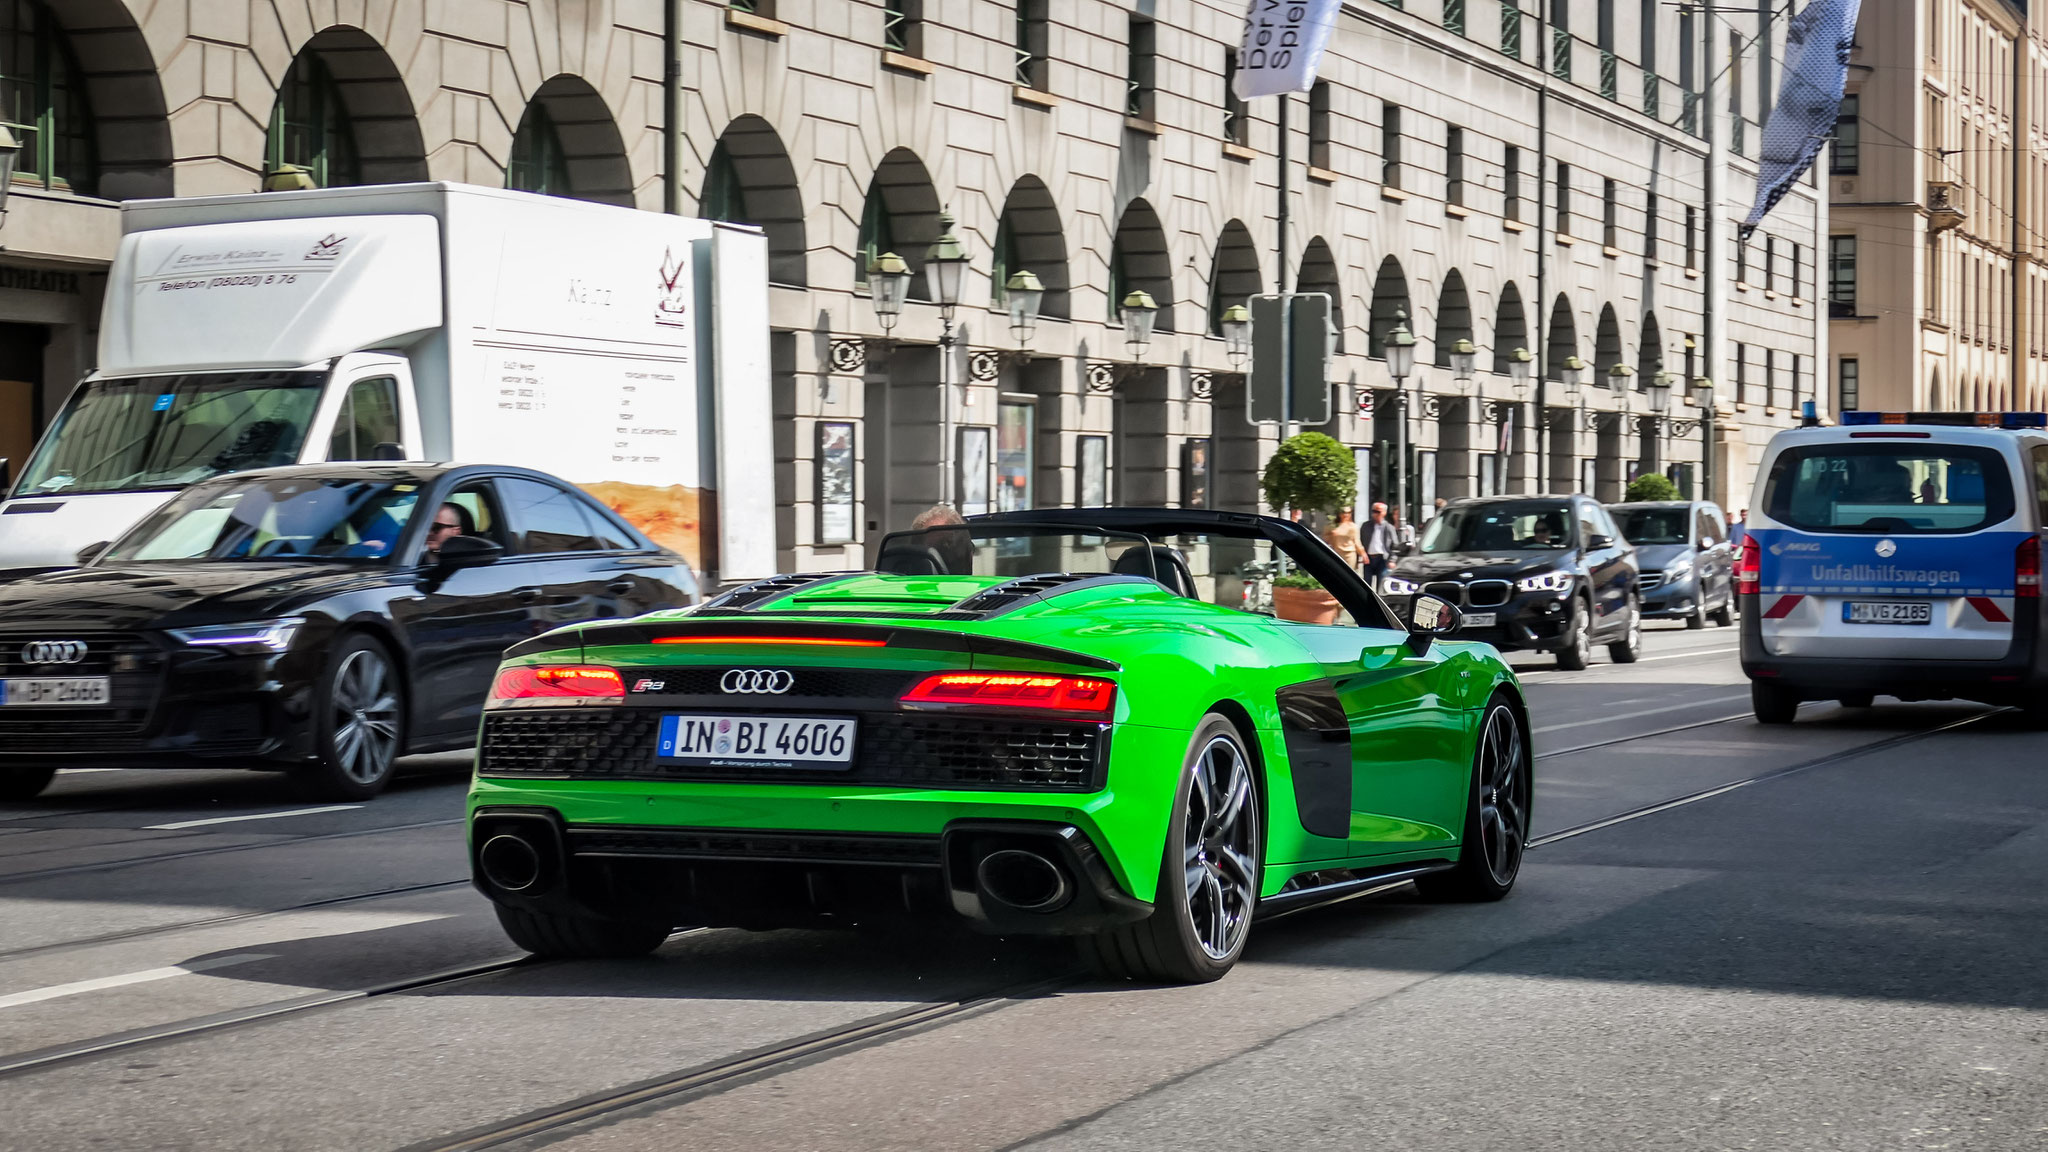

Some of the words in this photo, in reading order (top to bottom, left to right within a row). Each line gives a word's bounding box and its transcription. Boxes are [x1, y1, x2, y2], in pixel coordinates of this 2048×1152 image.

[1249, 18, 1274, 69] Der
[158, 280, 206, 291] Telefon
[207, 275, 263, 289] (08020)
[567, 278, 612, 306] Kaz
[1831, 459, 1848, 473] 22
[1784, 543, 1821, 552] MVG
[1811, 564, 1960, 587] Unfallhilfswagen
[1852, 604, 1862, 618] M
[1871, 604, 1890, 619] VG
[1893, 605, 1929, 620] 2185
[632, 678, 665, 692] R8
[663, 740, 671, 750] D
[681, 720, 715, 753] IN
[735, 721, 769, 755] BI
[775, 722, 846, 757] 4606
